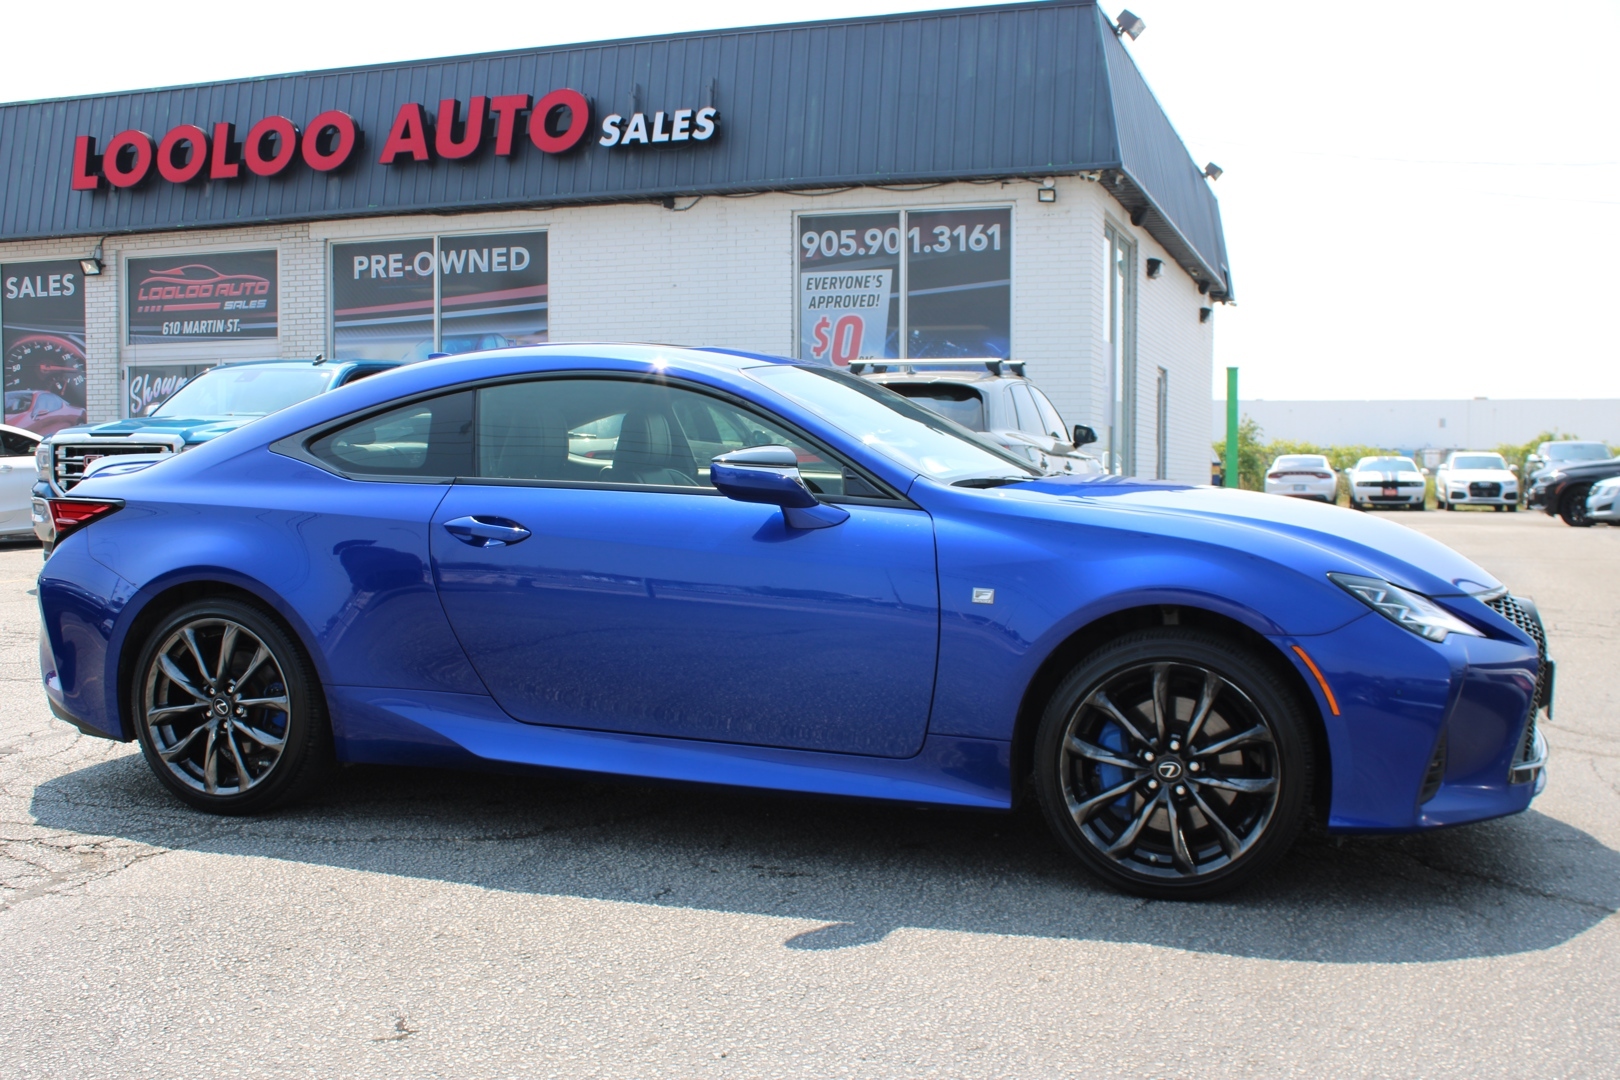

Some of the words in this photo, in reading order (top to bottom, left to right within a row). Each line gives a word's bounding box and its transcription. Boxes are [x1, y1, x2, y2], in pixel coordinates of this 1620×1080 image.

[72, 110, 358, 191] LOOLOO
[378, 88, 590, 165] AUTO
[599, 107, 717, 147] SALES
[801, 223, 1002, 258] 905.901.3161
[353, 246, 531, 279] PRE-OWNED
[6, 273, 75, 300] SALES
[137, 284, 214, 301] LOOLOO
[214, 281, 270, 297] AUTO
[806, 274, 884, 291] EVERYONE'S
[224, 299, 268, 310] SALES
[808, 293, 881, 309] APPROVED!
[162, 321, 181, 335] 610
[182, 319, 225, 334] MARTIN
[226, 318, 241, 333] ST.
[812, 314, 865, 367] $0
